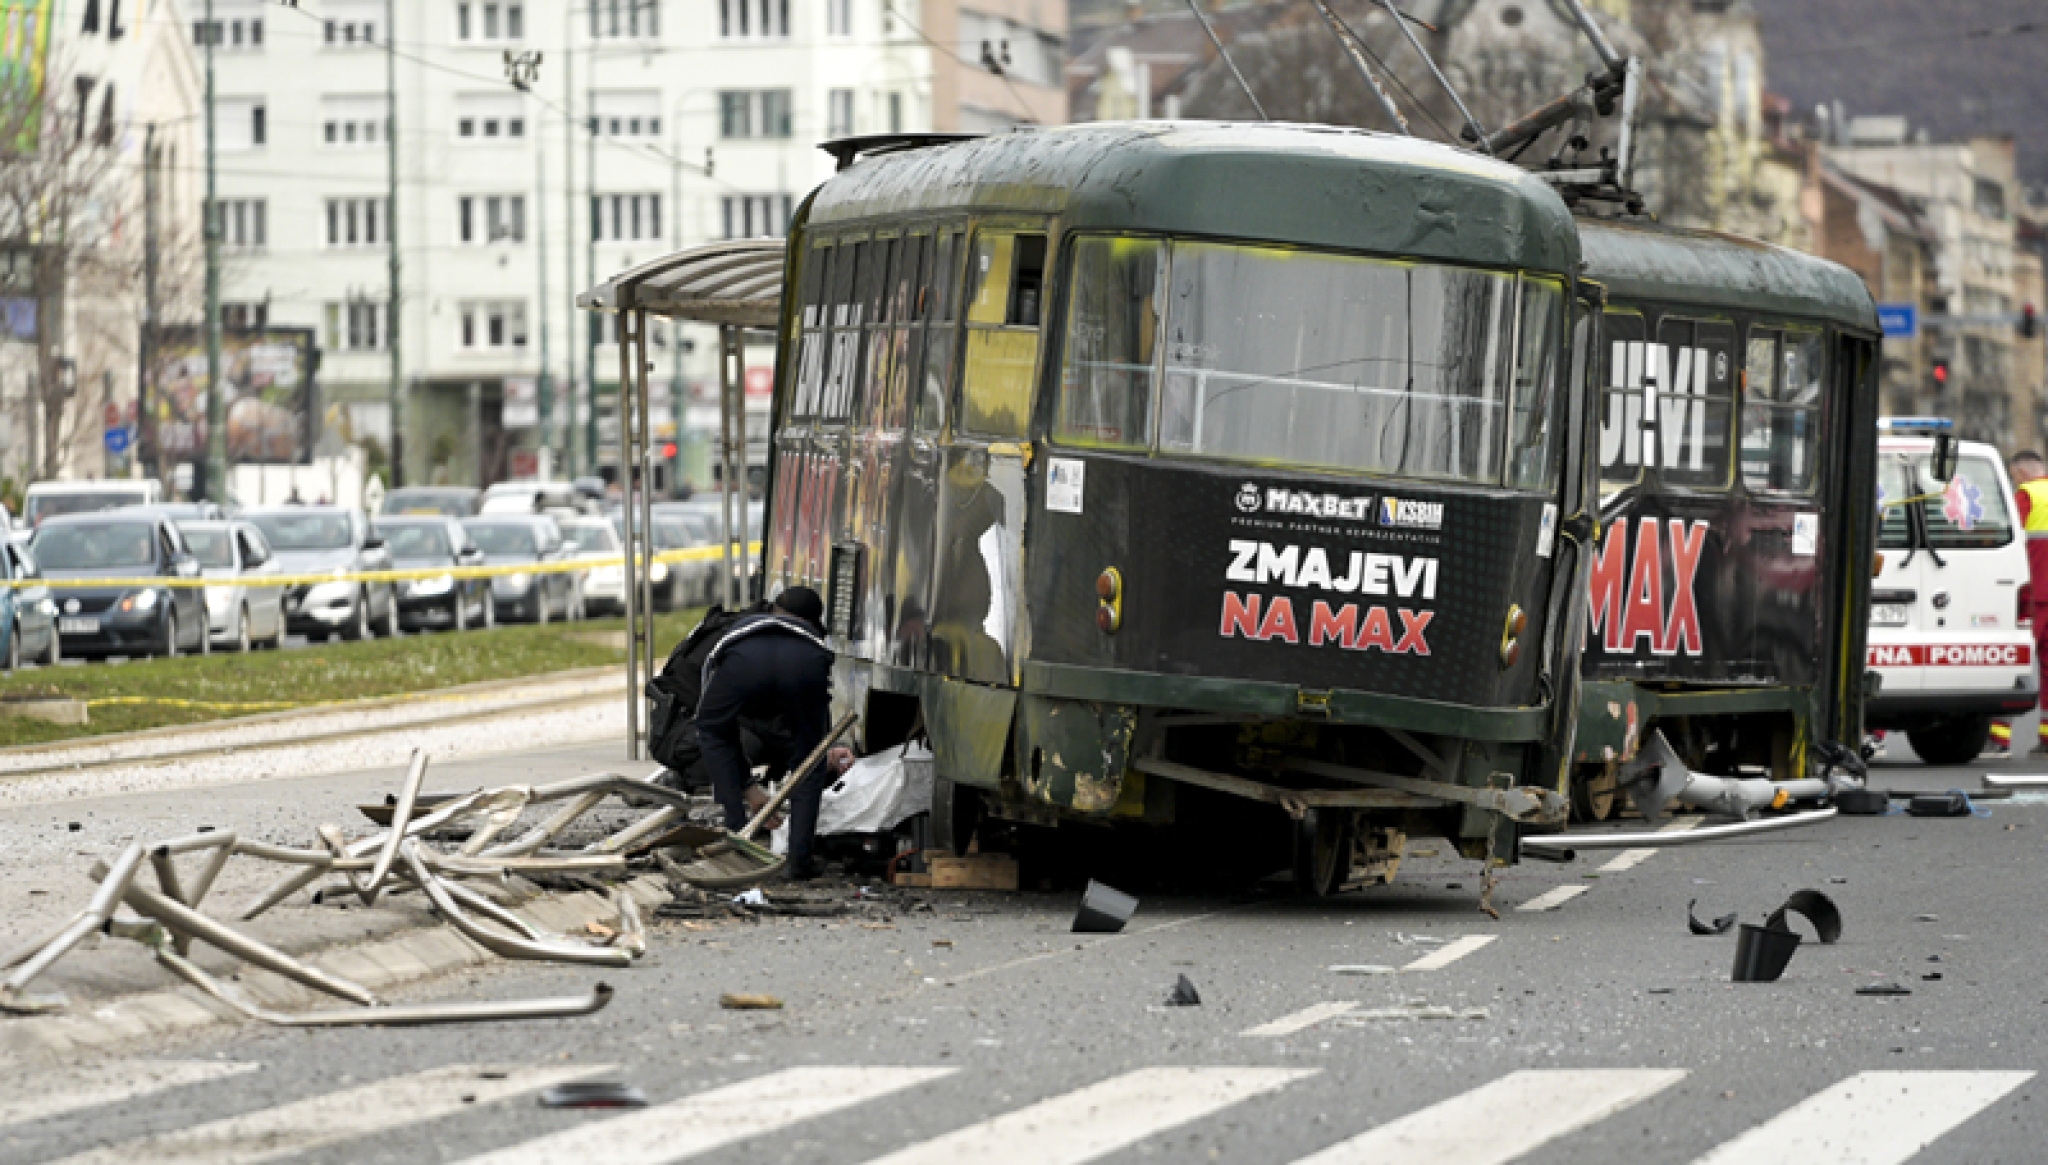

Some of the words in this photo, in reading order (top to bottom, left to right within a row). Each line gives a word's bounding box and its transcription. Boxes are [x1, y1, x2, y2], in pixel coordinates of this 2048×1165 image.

[1226, 539, 1439, 600] ZMAJEVI
[1219, 591, 1299, 643] NA
[1308, 598, 1434, 656] MAX
